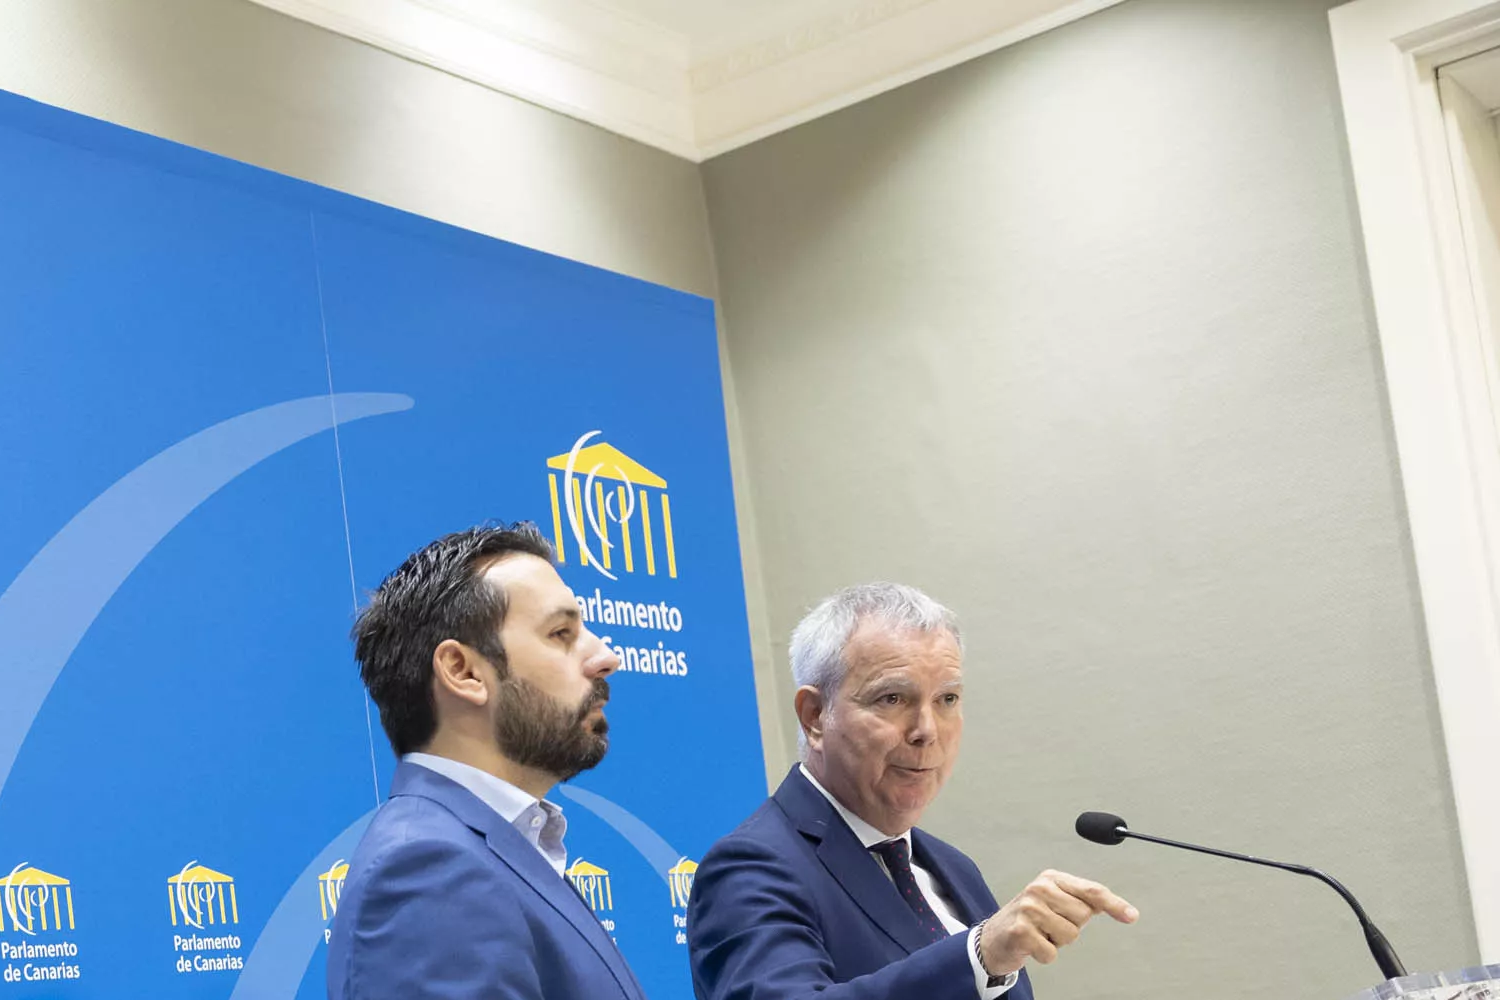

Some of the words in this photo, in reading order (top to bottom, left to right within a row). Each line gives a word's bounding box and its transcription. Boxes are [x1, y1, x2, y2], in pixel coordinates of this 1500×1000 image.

[568, 586, 683, 633] arlamento
[0, 940, 78, 960] Parlamento
[173, 933, 241, 951] Parlamento
[3, 963, 21, 982] de
[23, 961, 80, 981] Canarias
[176, 955, 192, 973] de
[193, 953, 244, 972] Canarias
